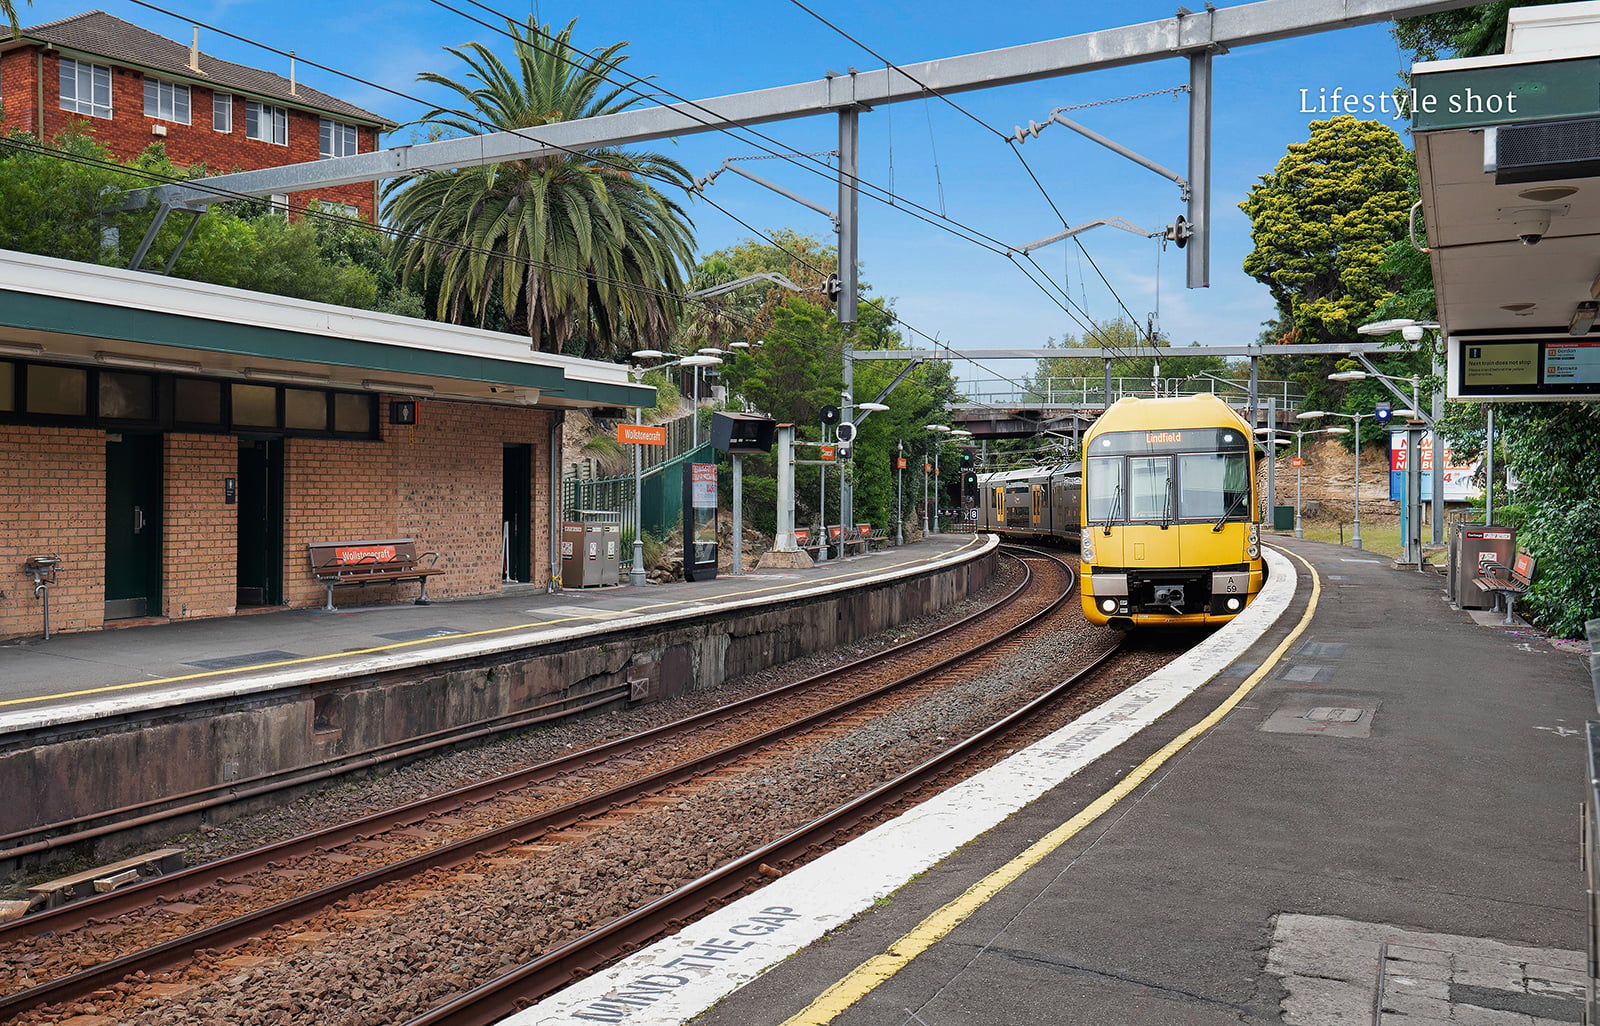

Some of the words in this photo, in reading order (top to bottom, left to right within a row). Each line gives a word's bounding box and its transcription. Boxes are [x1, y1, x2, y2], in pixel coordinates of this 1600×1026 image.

[625, 429, 661, 441] Wollstonecraft
[1146, 431, 1182, 444] Lindfield
[342, 548, 391, 561] Wollstonecraft
[1228, 576, 1235, 584] A
[1226, 585, 1237, 593] 59
[570, 973, 690, 1023] MIND
[662, 937, 756, 969] THE
[728, 905, 803, 936] GAP
